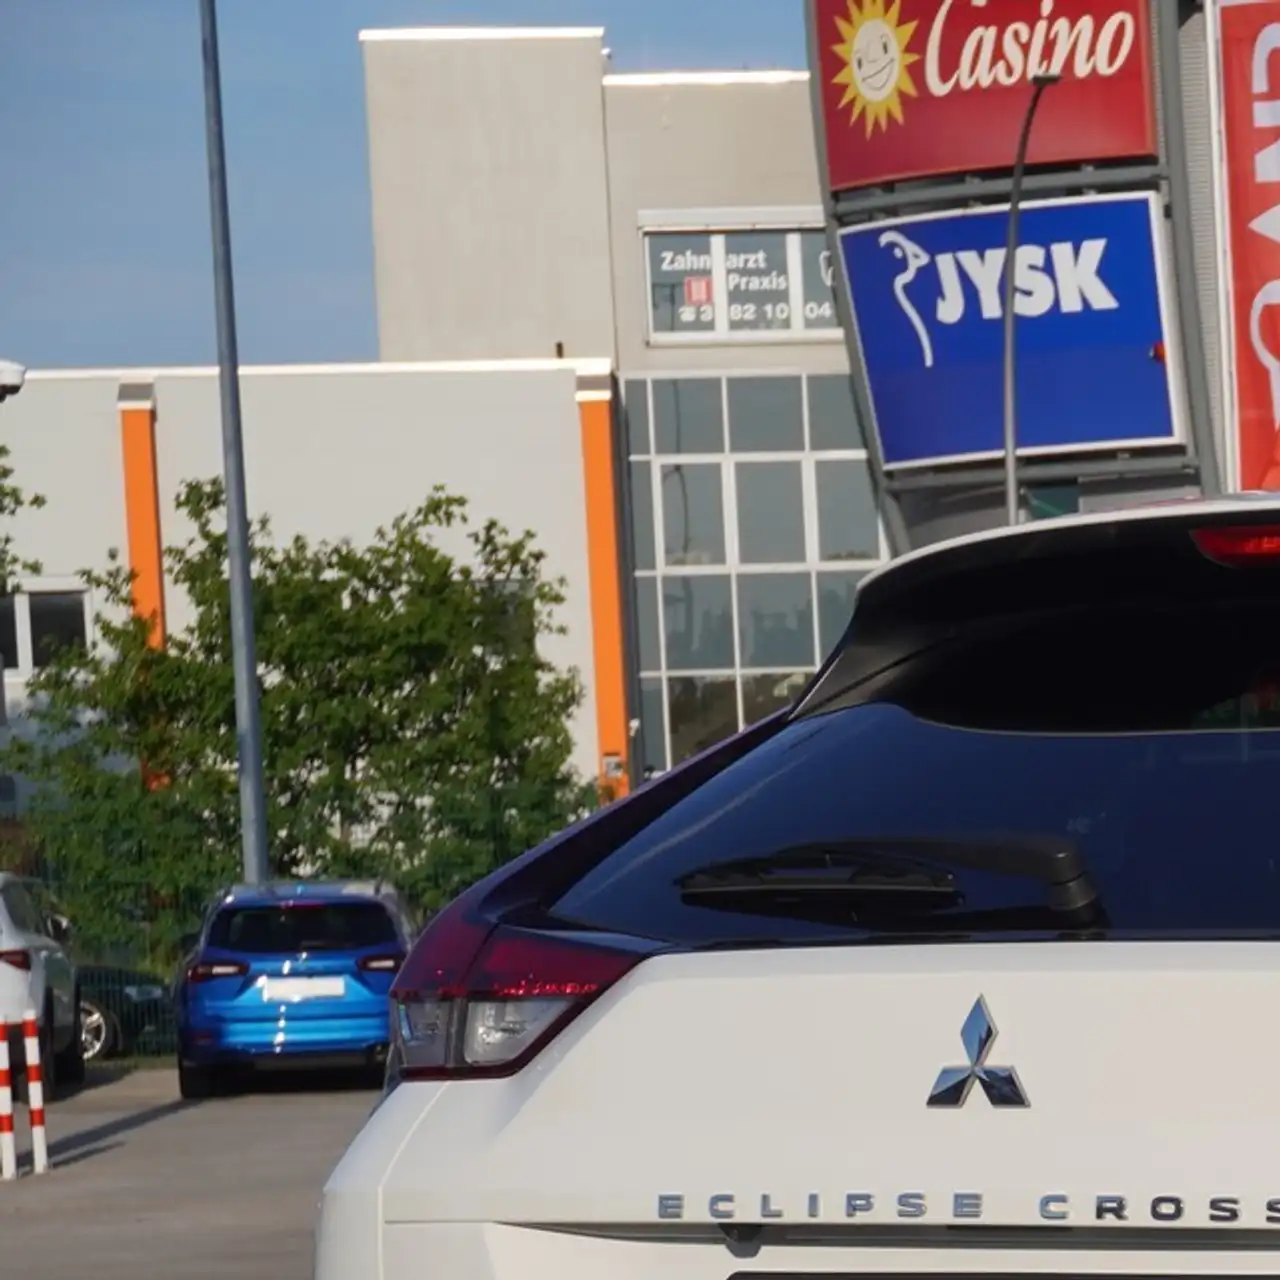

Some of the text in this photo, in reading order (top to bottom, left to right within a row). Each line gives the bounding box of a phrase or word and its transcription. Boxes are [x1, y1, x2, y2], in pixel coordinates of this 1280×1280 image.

[924, 0, 1135, 98] Casino
[728, 270, 787, 291] Praxis
[934, 238, 1120, 325] JYSK
[804, 301, 833, 319] 04
[657, 1192, 984, 1219] ECLIPSE
